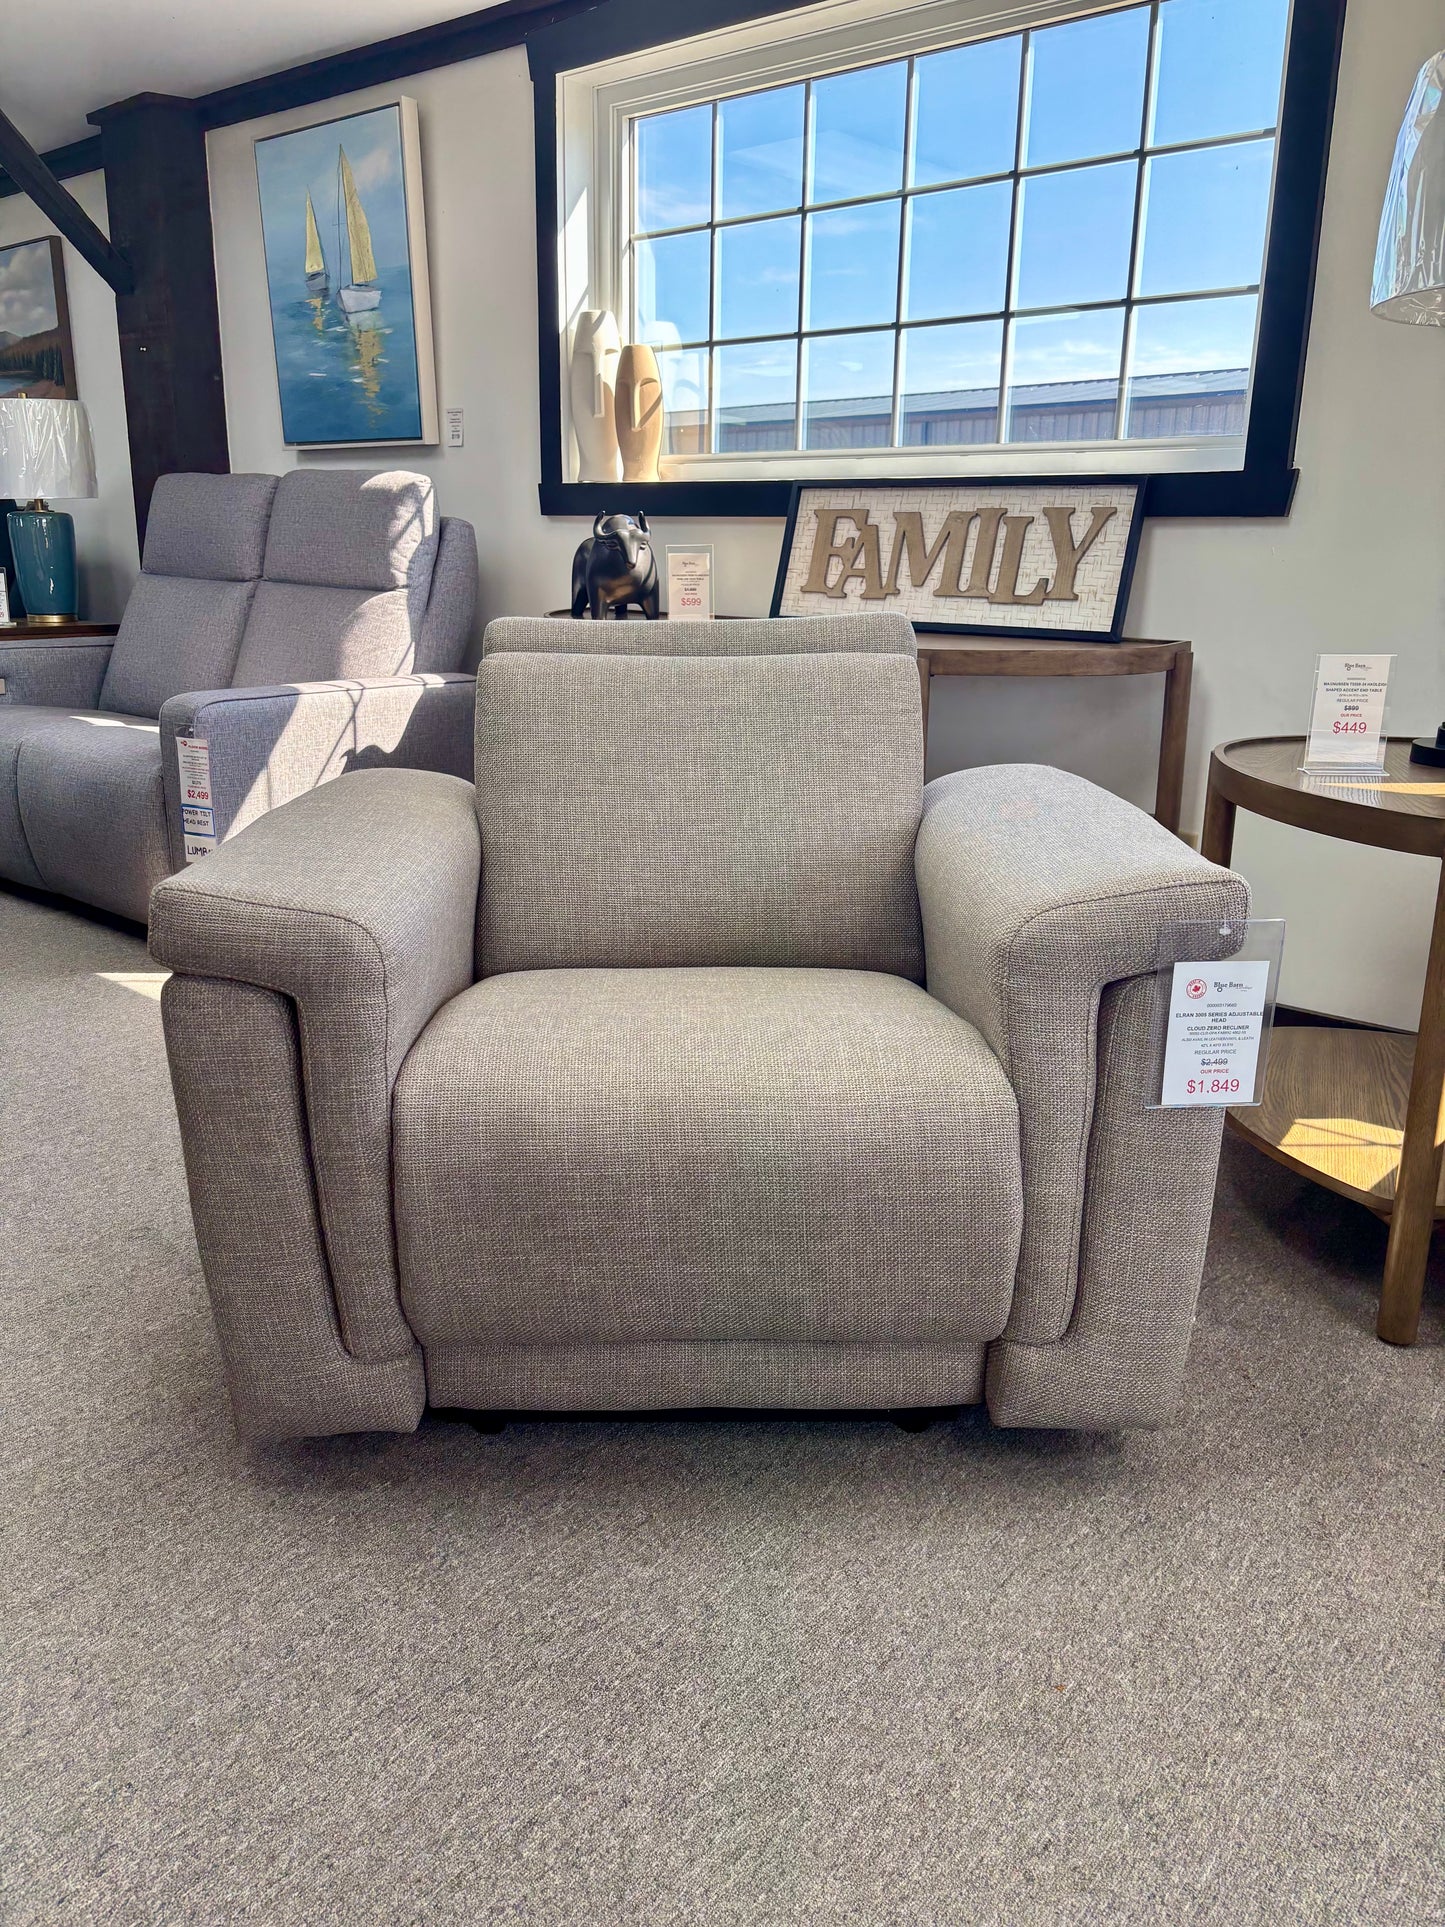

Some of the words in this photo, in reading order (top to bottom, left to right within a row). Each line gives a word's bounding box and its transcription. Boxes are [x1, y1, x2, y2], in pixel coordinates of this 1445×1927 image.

[800, 507, 1117, 605] FAMILY
[681, 598, 701, 606] $599
[1332, 721, 1367, 734] $449
[188, 789, 208, 800] $2,499
[1214, 981, 1228, 992] Blue
